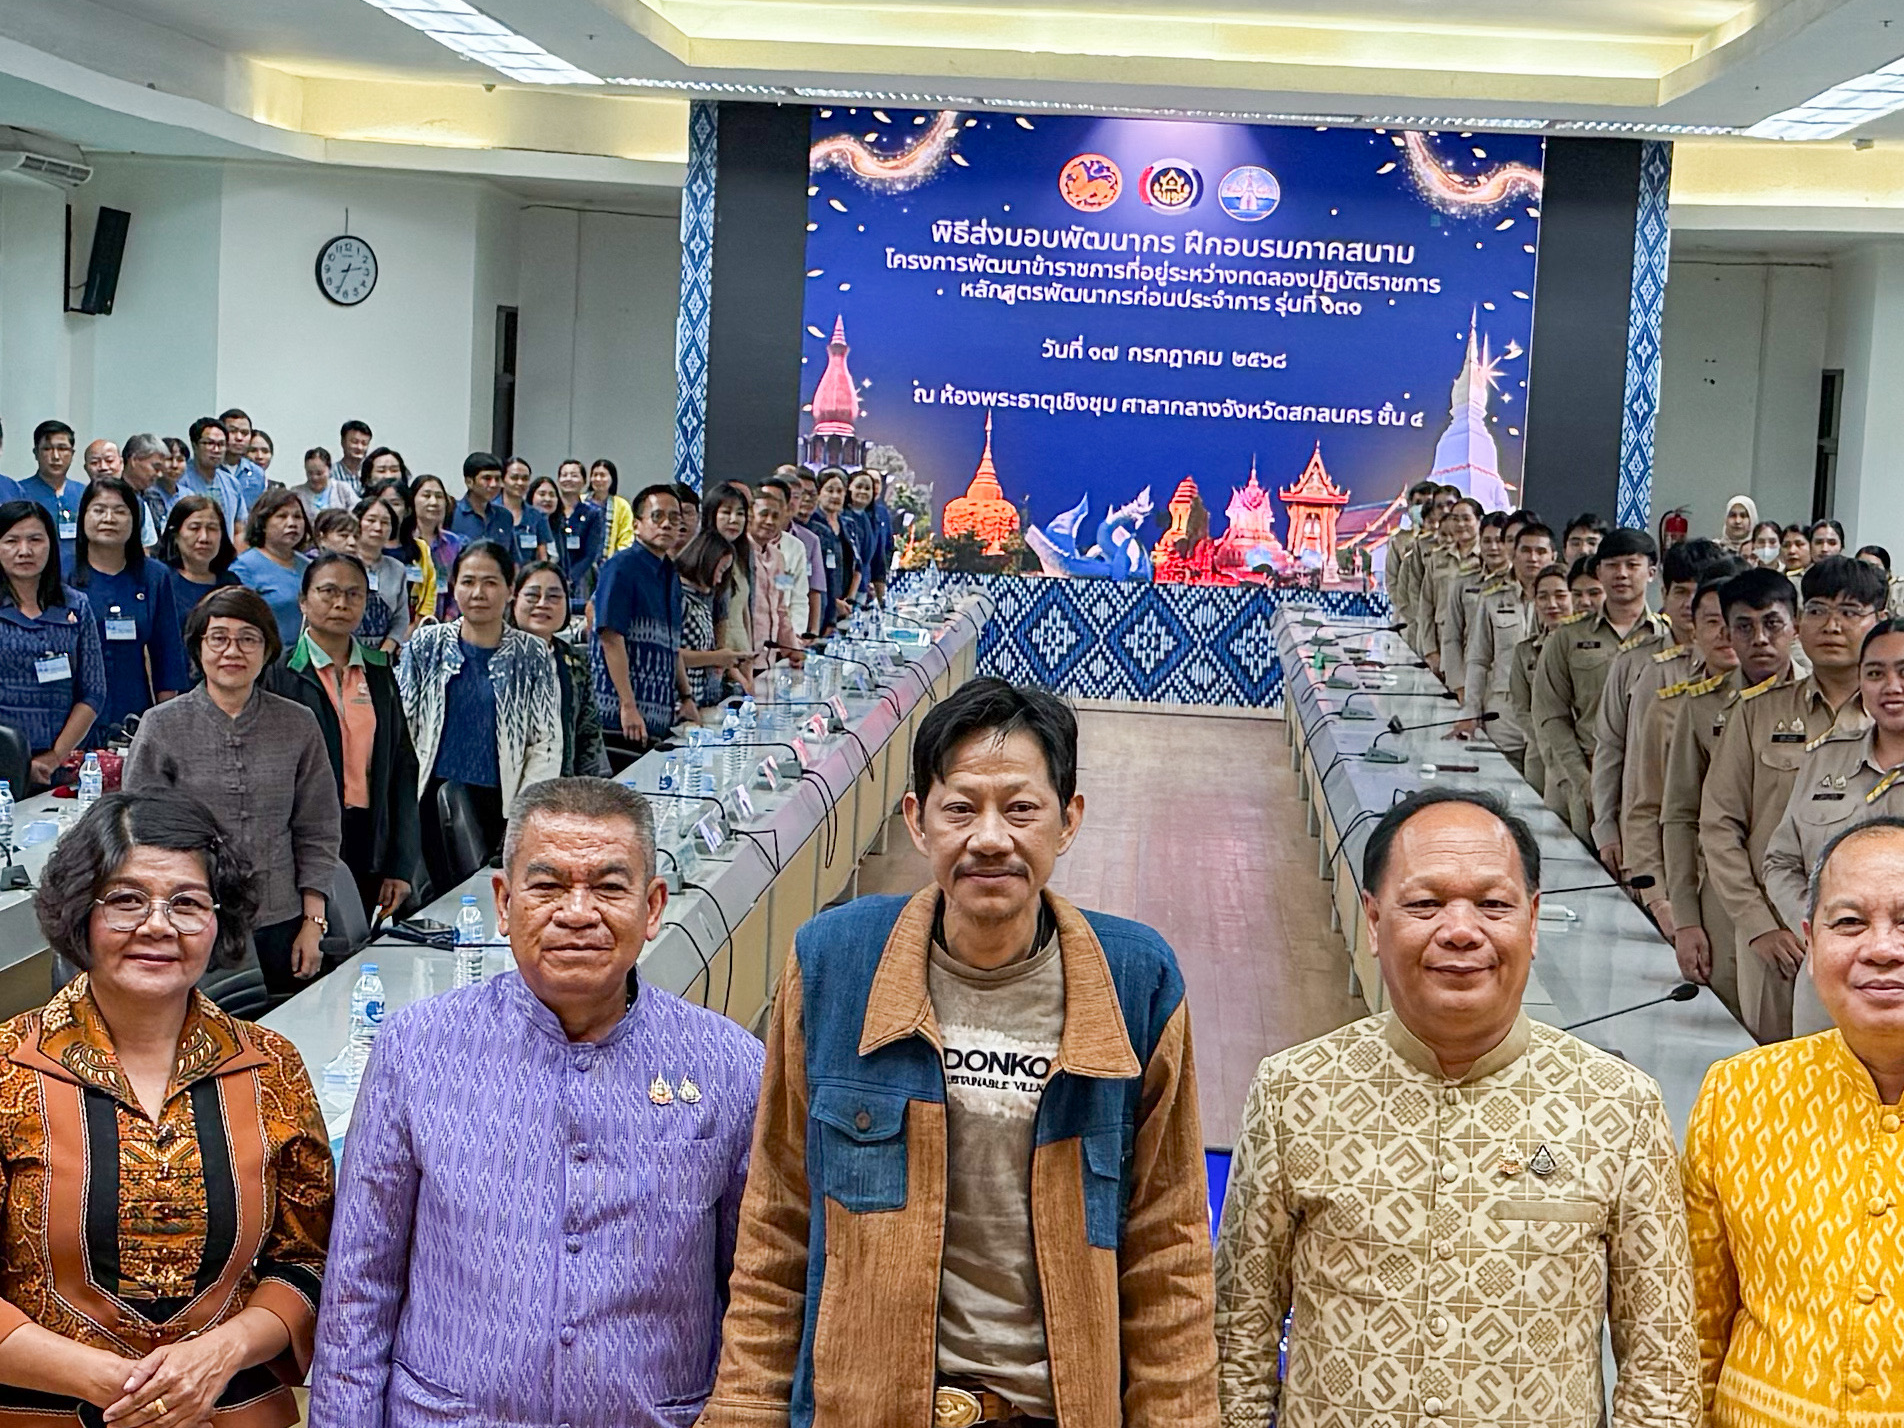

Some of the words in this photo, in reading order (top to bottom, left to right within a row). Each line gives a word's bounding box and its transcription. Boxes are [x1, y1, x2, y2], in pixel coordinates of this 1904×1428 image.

[931, 218, 1176, 254] พิธีส่งมอบพัฒนากร
[1184, 229, 1415, 265] ฝึกอบรมภาคสนาม
[1275, 289, 1317, 317] รุ่นที่
[1042, 334, 1083, 359] วันที่
[1088, 345, 1119, 361] ๑๗
[1128, 346, 1223, 369] กรกฎาคม
[1232, 351, 1287, 369] ๒๕๖๘
[913, 386, 935, 404] ณ
[940, 383, 1117, 416] ห้องพระธาตุเชิงชุม
[1121, 396, 1374, 426] ศาลากลางจังหวัดสกลนคร
[1377, 401, 1405, 426] ชั้น
